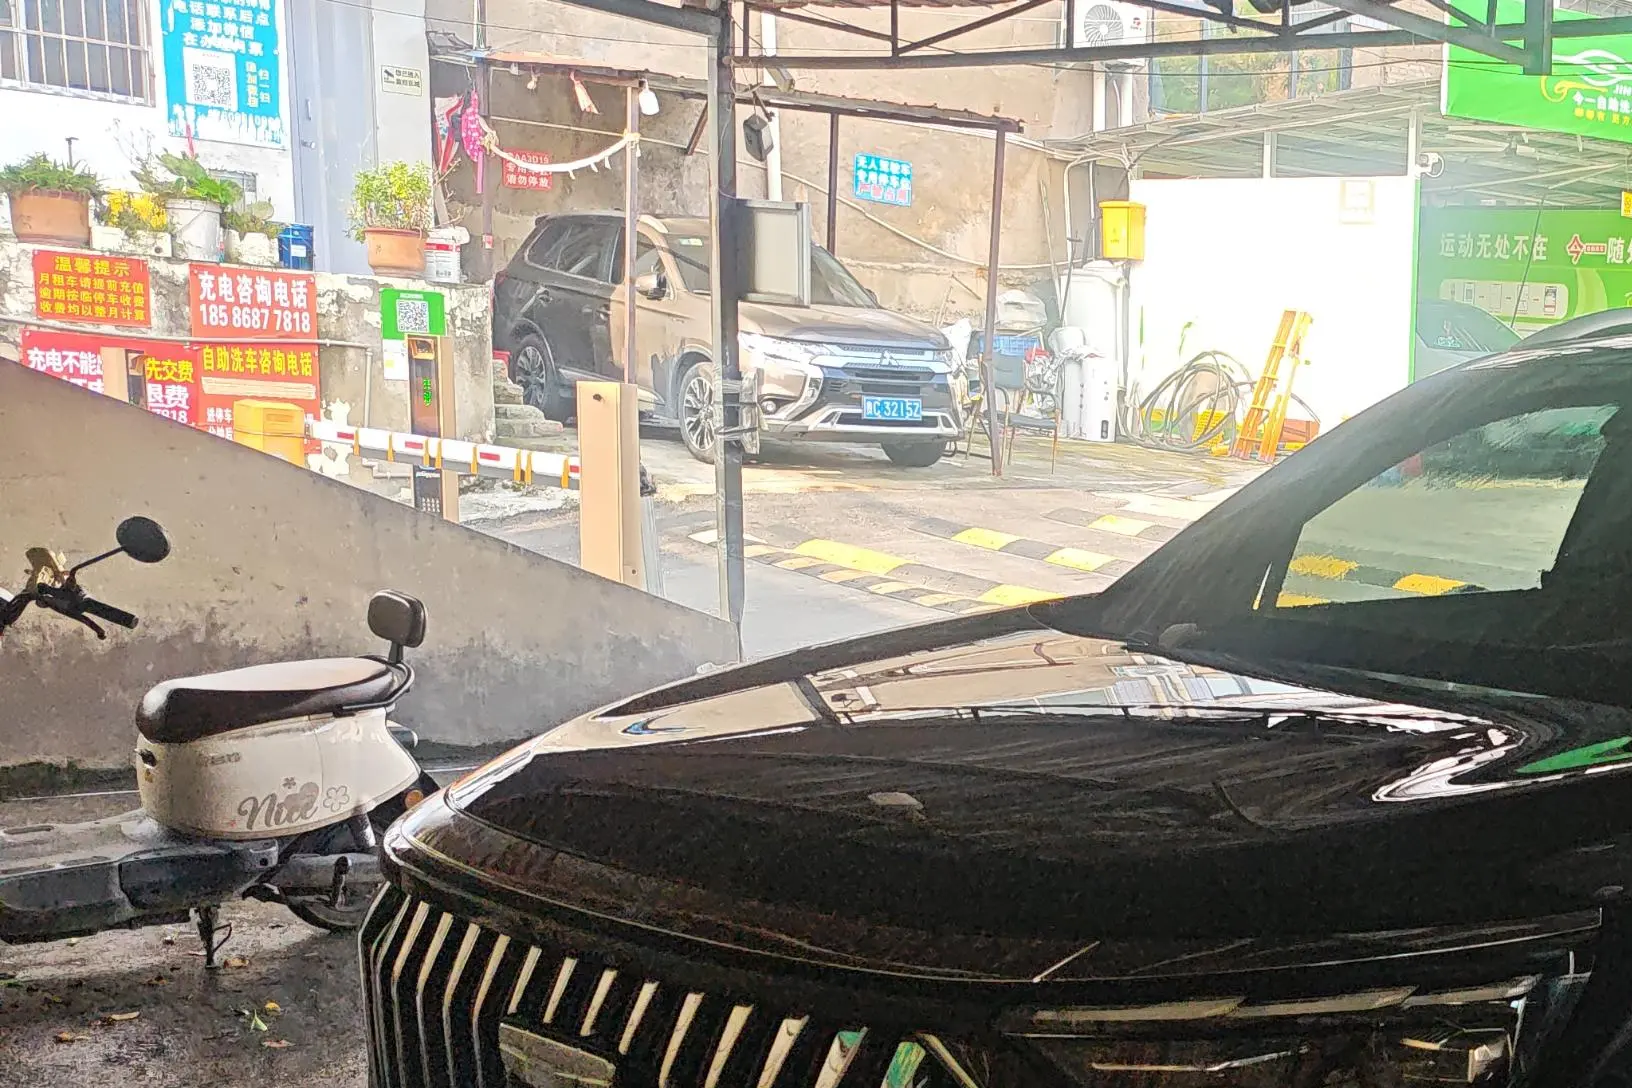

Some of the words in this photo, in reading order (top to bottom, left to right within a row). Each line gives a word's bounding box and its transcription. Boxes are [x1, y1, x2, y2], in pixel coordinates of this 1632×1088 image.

[191, 17, 255, 40] 添加微信
[258, 68, 271, 104] 扫一扫
[1440, 233, 1549, 262] 运动无处不在
[54, 256, 130, 277] 温馨提示
[40, 272, 144, 294] 月租车请提前充值
[40, 287, 145, 308] 逾期按临停车收费
[198, 270, 308, 309] 充电咨询电话
[40, 301, 145, 321] 收费均以整月计算
[199, 303, 229, 326] 185
[232, 305, 269, 330] 8687
[273, 309, 311, 333] 7818
[27, 347, 103, 376] 充电不能
[203, 344, 313, 377] 自助洗车咨询电话
